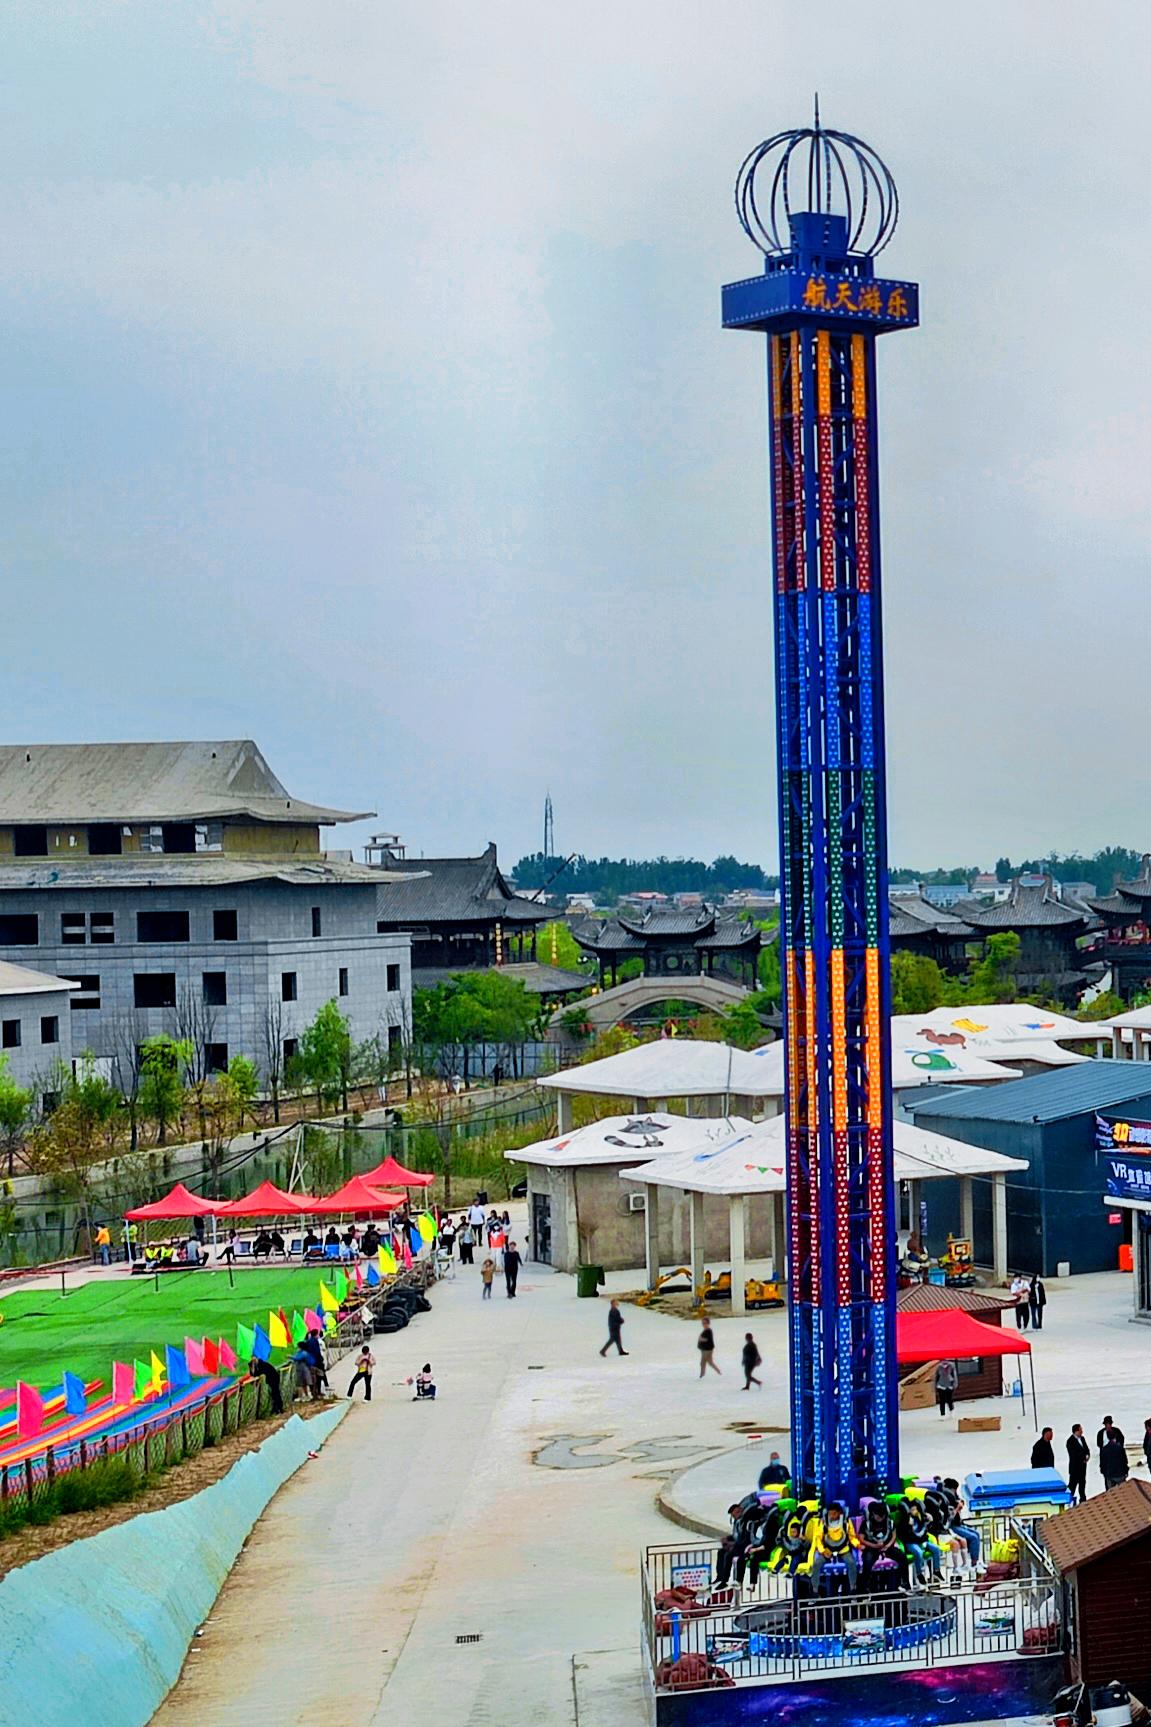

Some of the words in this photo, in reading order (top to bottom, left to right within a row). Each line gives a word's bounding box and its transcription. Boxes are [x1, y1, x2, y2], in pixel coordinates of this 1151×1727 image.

[803, 277, 908, 317] 航天游乐
[1111, 1162, 1127, 1178] VR
